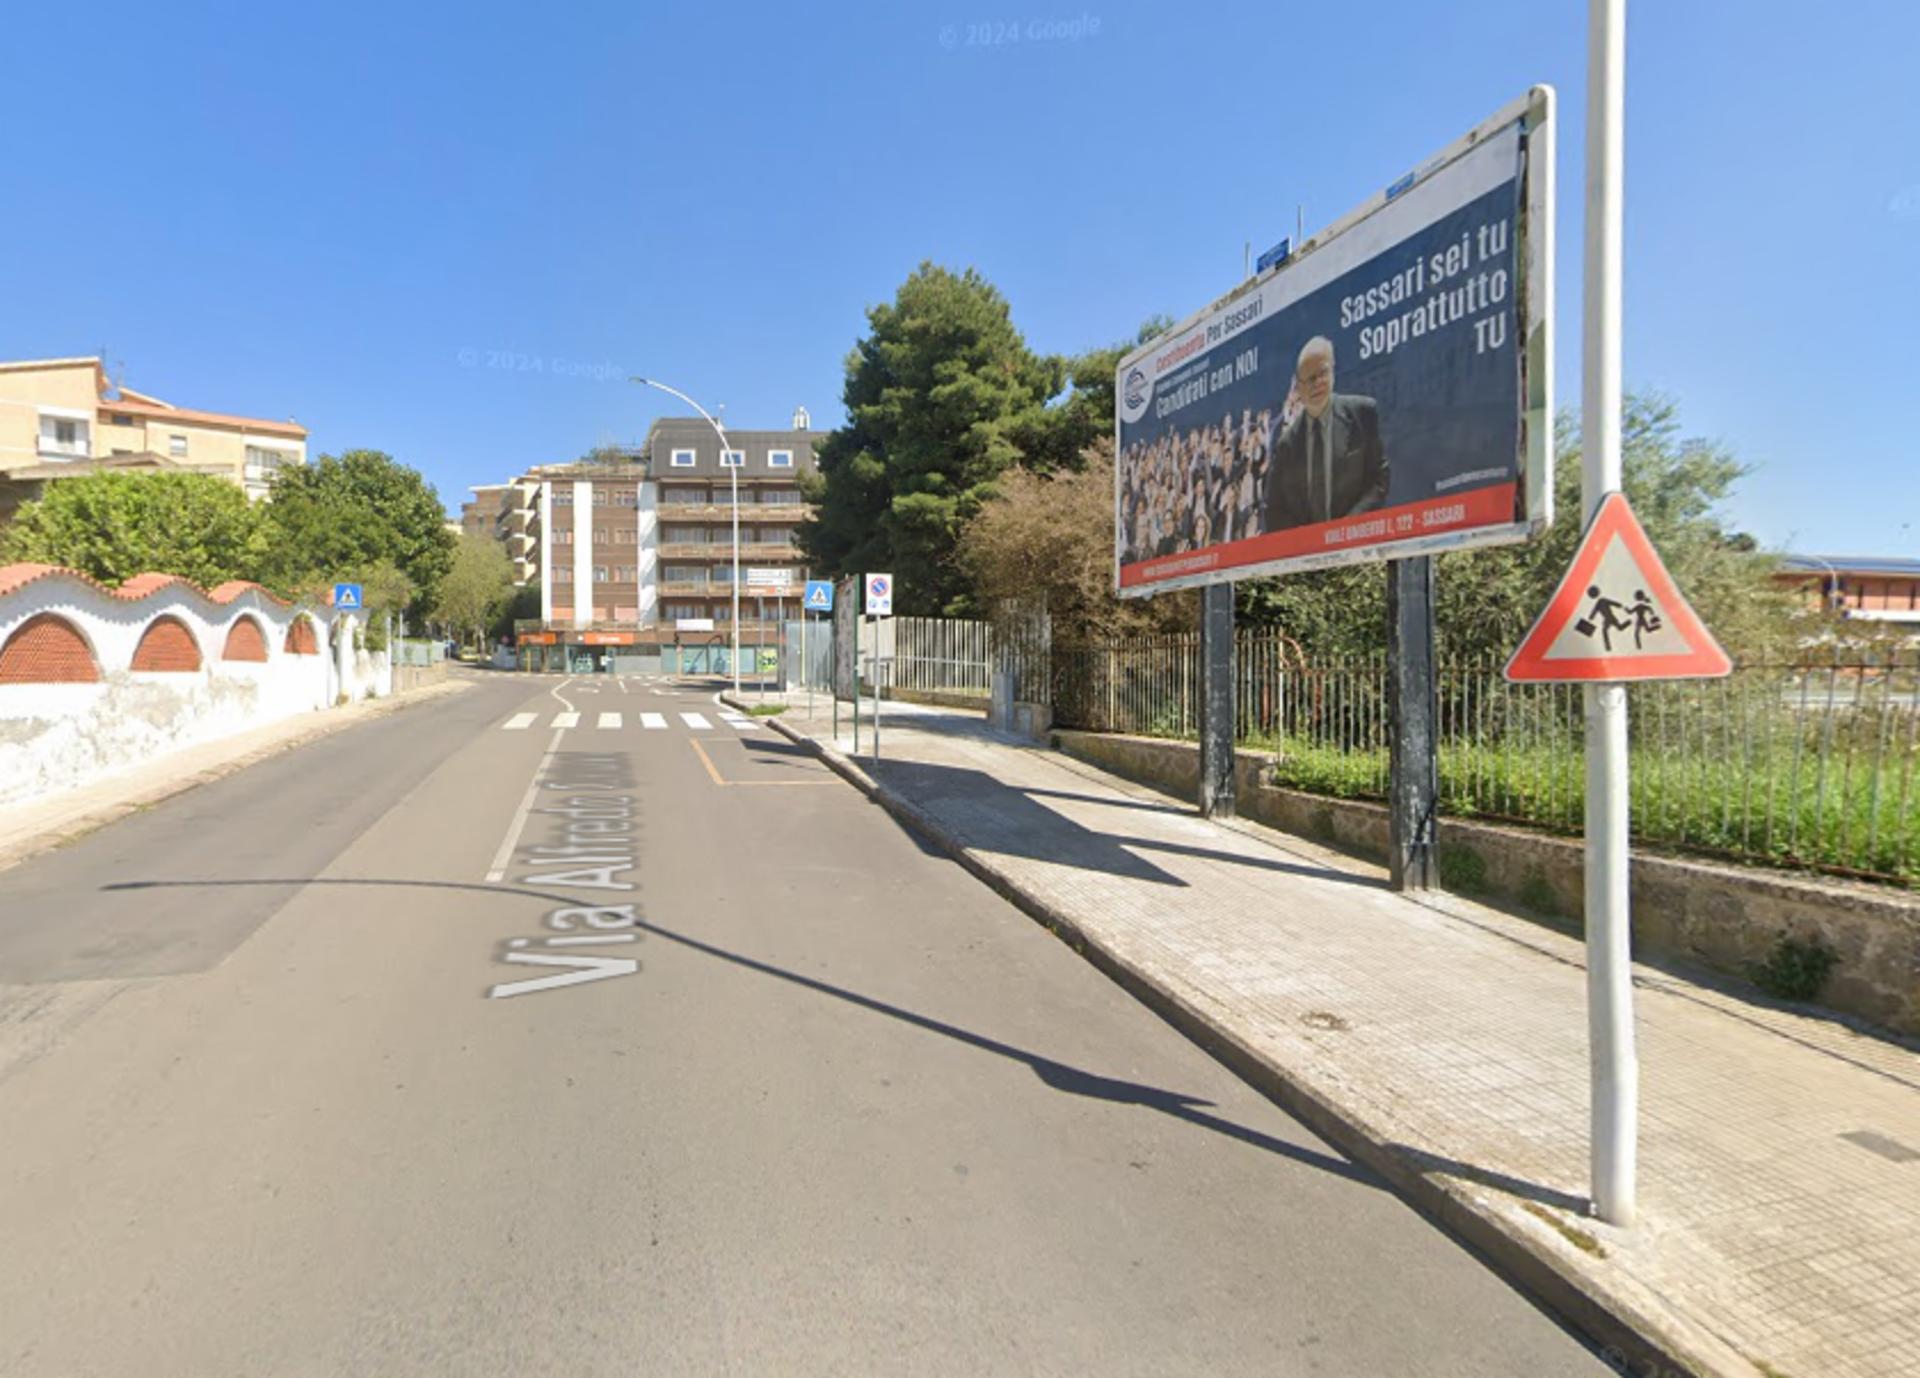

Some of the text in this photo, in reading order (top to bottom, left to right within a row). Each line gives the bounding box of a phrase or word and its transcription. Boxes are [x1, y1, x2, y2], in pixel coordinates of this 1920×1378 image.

[1341, 256, 1424, 328] Sassari
[1430, 232, 1470, 284] sei
[1478, 219, 1507, 261] tu
[1224, 293, 1263, 334] Sassari
[1359, 269, 1507, 360] Soprattutto
[1474, 311, 1506, 354] TU
[1211, 362, 1233, 392] con
[1236, 346, 1258, 381] NOI
[1423, 504, 1466, 528] SASSARI
